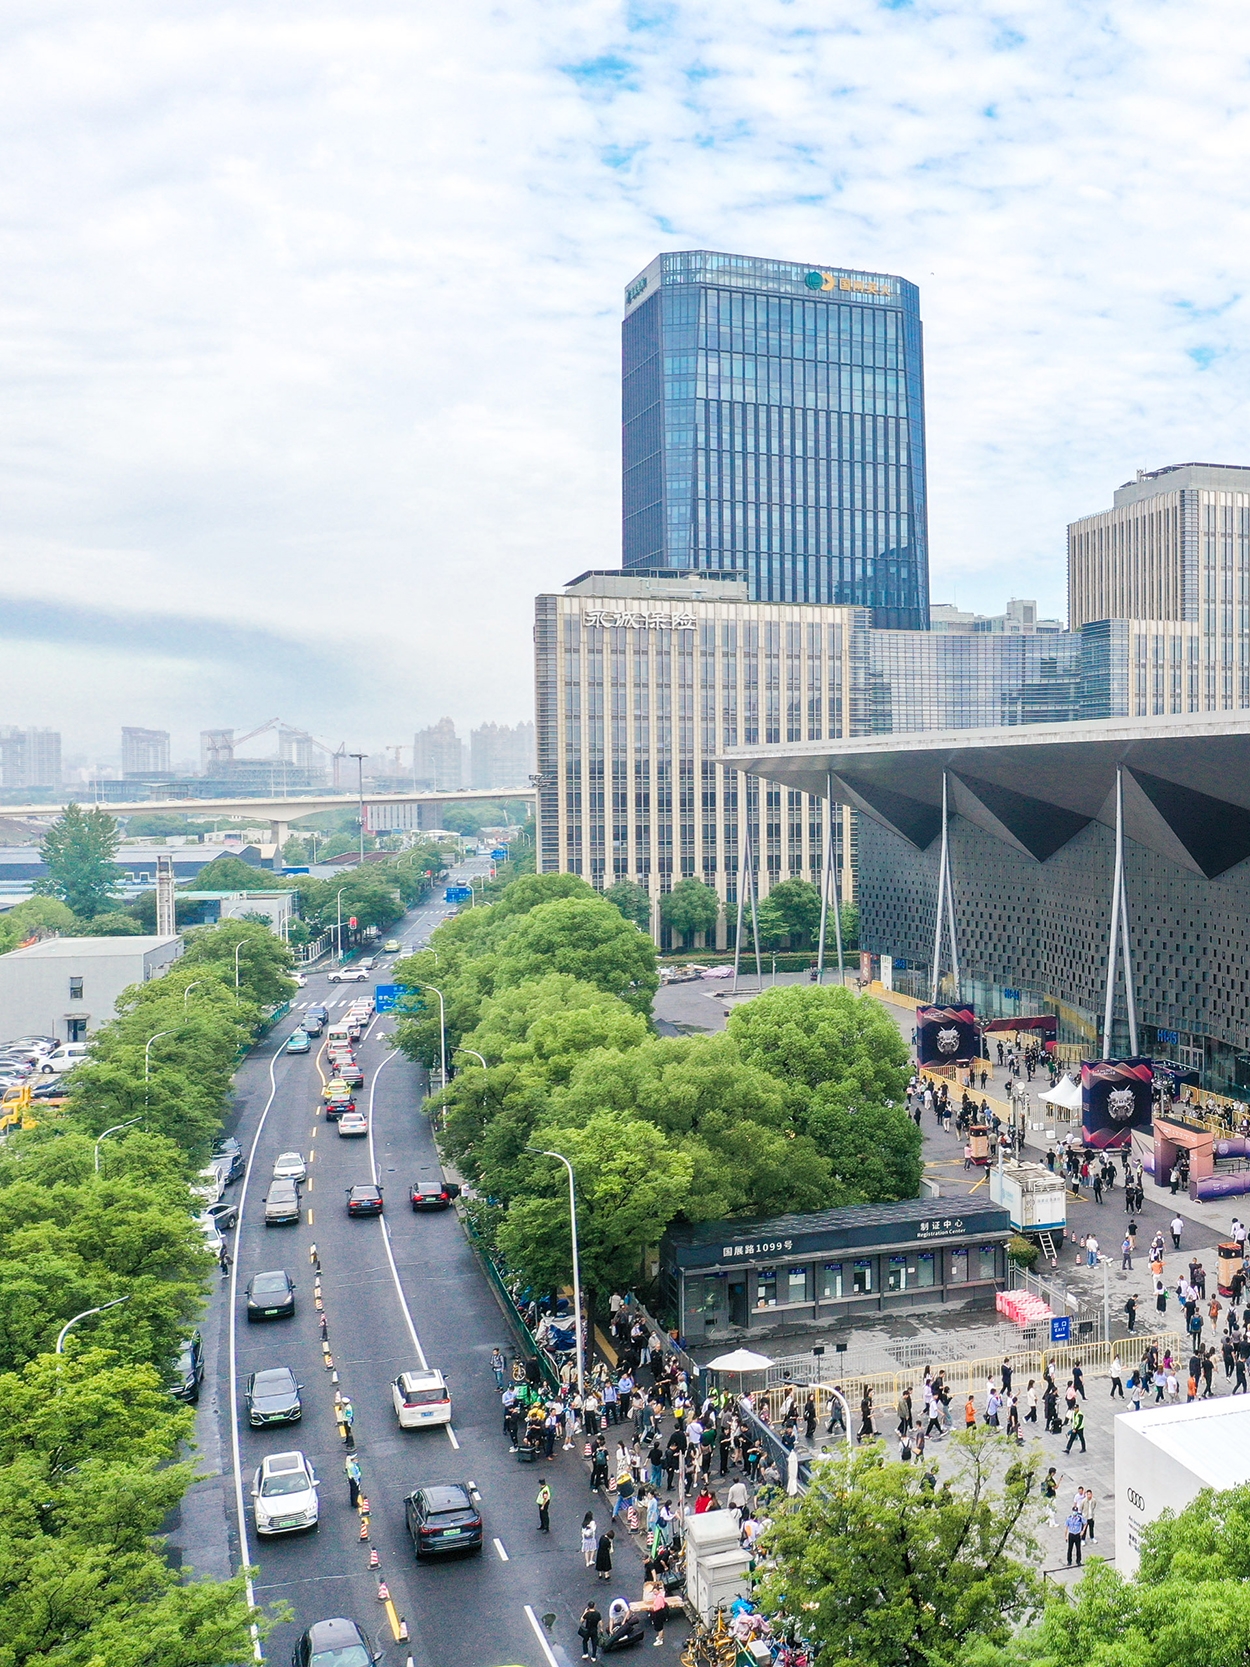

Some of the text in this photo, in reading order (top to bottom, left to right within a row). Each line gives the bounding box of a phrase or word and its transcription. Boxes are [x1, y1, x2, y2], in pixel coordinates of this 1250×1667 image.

[584, 609, 697, 630] 永诚保险
[920, 1219, 963, 1231] 制证中心
[917, 1230, 949, 1238] Registration
[723, 1240, 793, 1257] 国展路1099号
